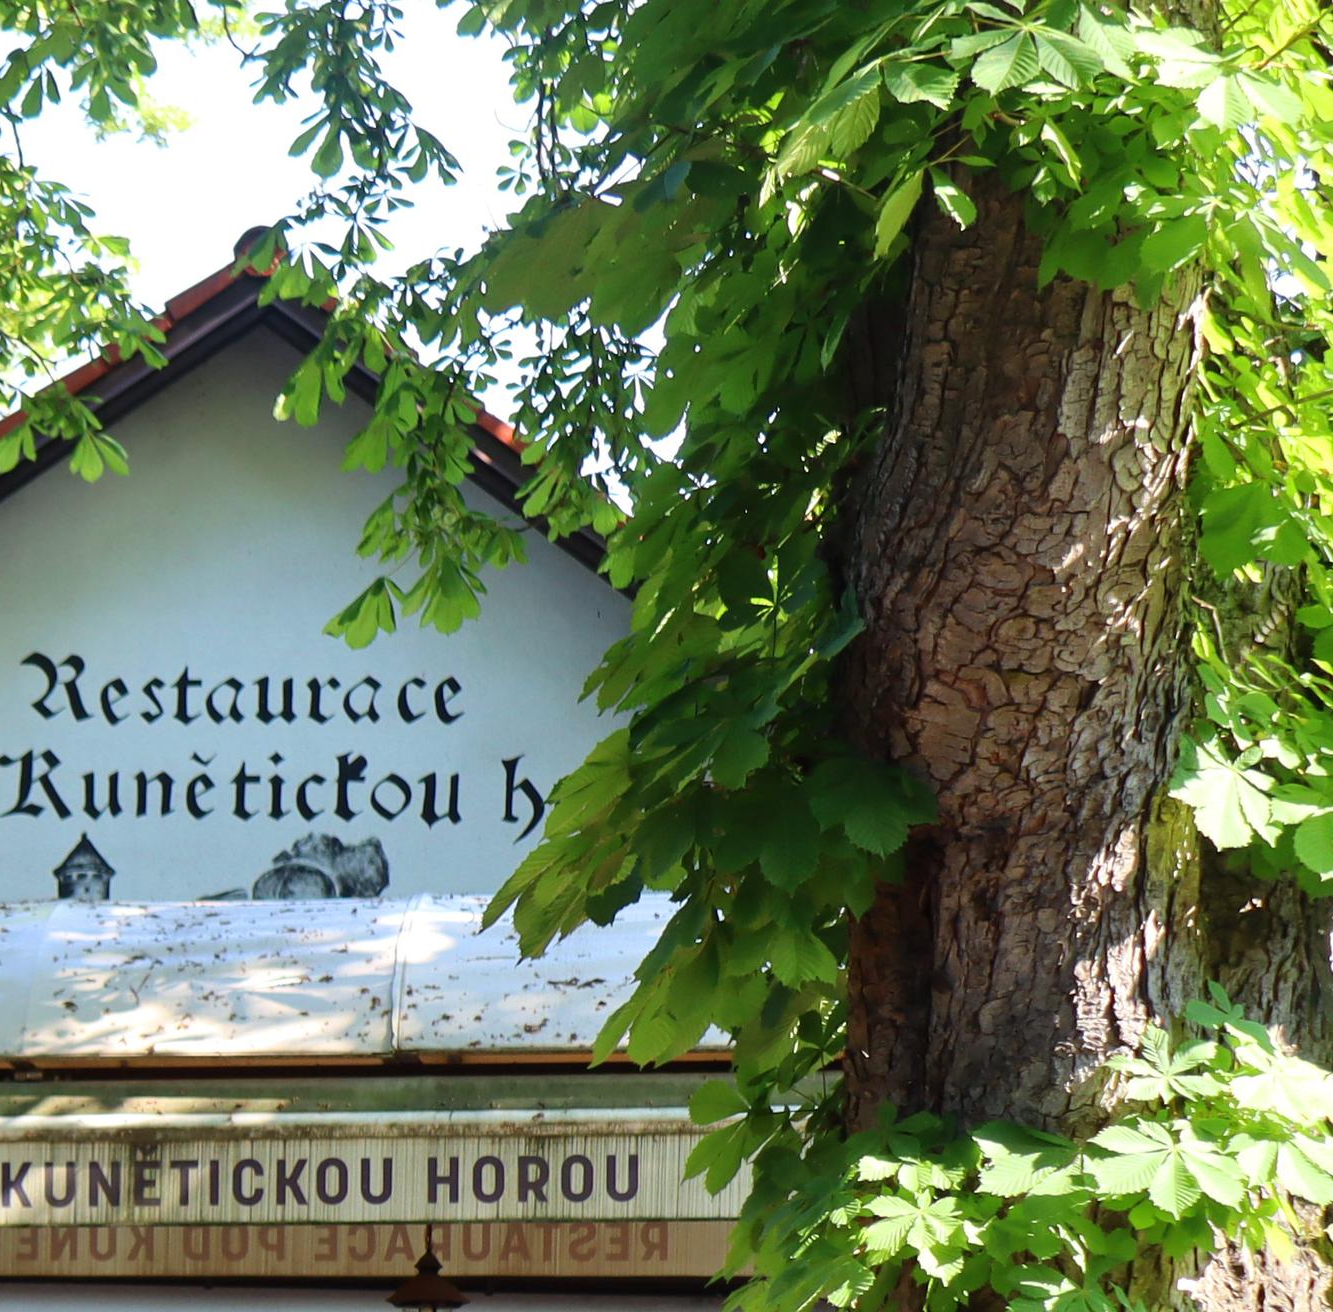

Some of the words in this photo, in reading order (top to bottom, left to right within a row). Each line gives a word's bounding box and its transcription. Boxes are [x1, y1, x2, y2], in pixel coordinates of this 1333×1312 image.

[21, 651, 465, 725] Restaurace
[0, 1144, 393, 1210] KUNĚTICKOU
[426, 1153, 640, 1205] HOROU
